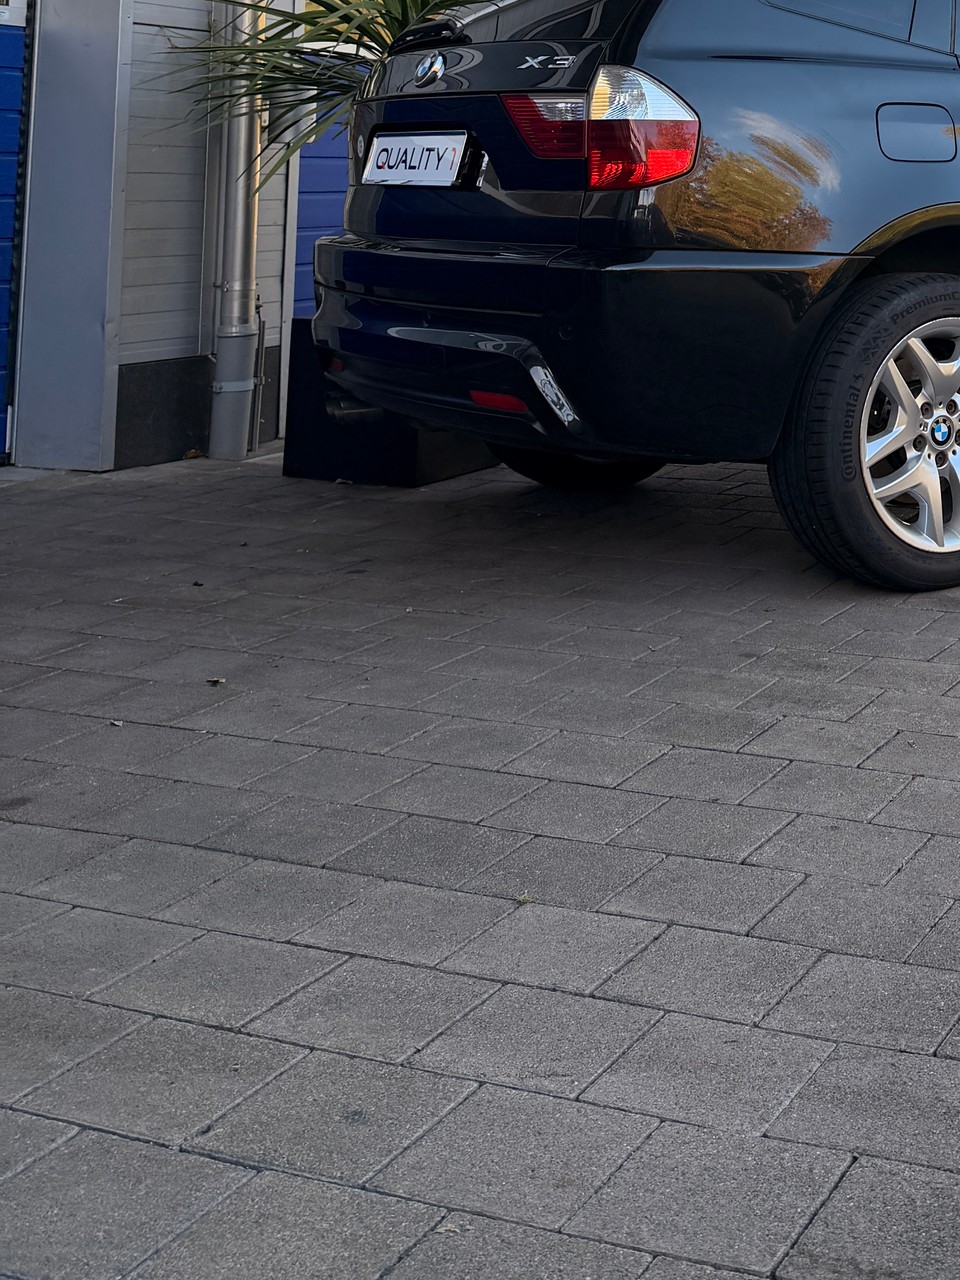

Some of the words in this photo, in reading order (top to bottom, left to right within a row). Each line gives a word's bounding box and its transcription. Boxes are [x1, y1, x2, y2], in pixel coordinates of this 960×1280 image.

[516, 55, 578, 70] X3
[376, 147, 448, 170] QUALITY
[449, 147, 457, 170] 1
[840, 385, 861, 481] Continental
